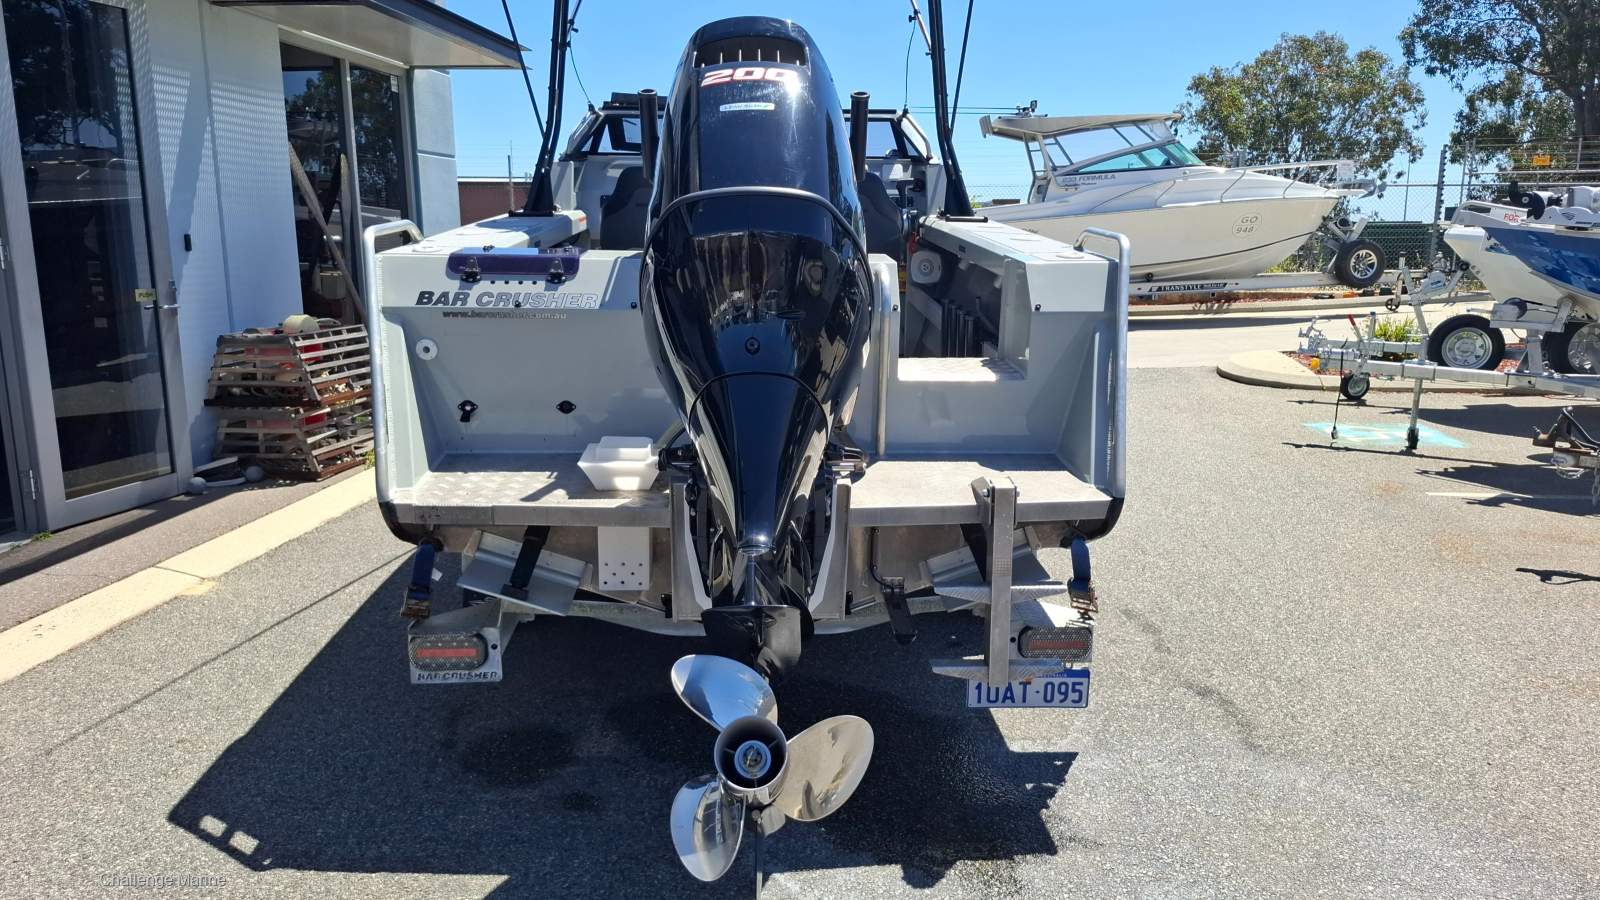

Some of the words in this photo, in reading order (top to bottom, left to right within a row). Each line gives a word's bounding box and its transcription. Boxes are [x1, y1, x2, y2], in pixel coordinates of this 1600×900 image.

[701, 66, 799, 89] 200
[1079, 174, 1117, 182] FORMULA
[1240, 215, 1259, 224] GO
[415, 290, 471, 307] BAR
[475, 291, 601, 309] CRUSHER
